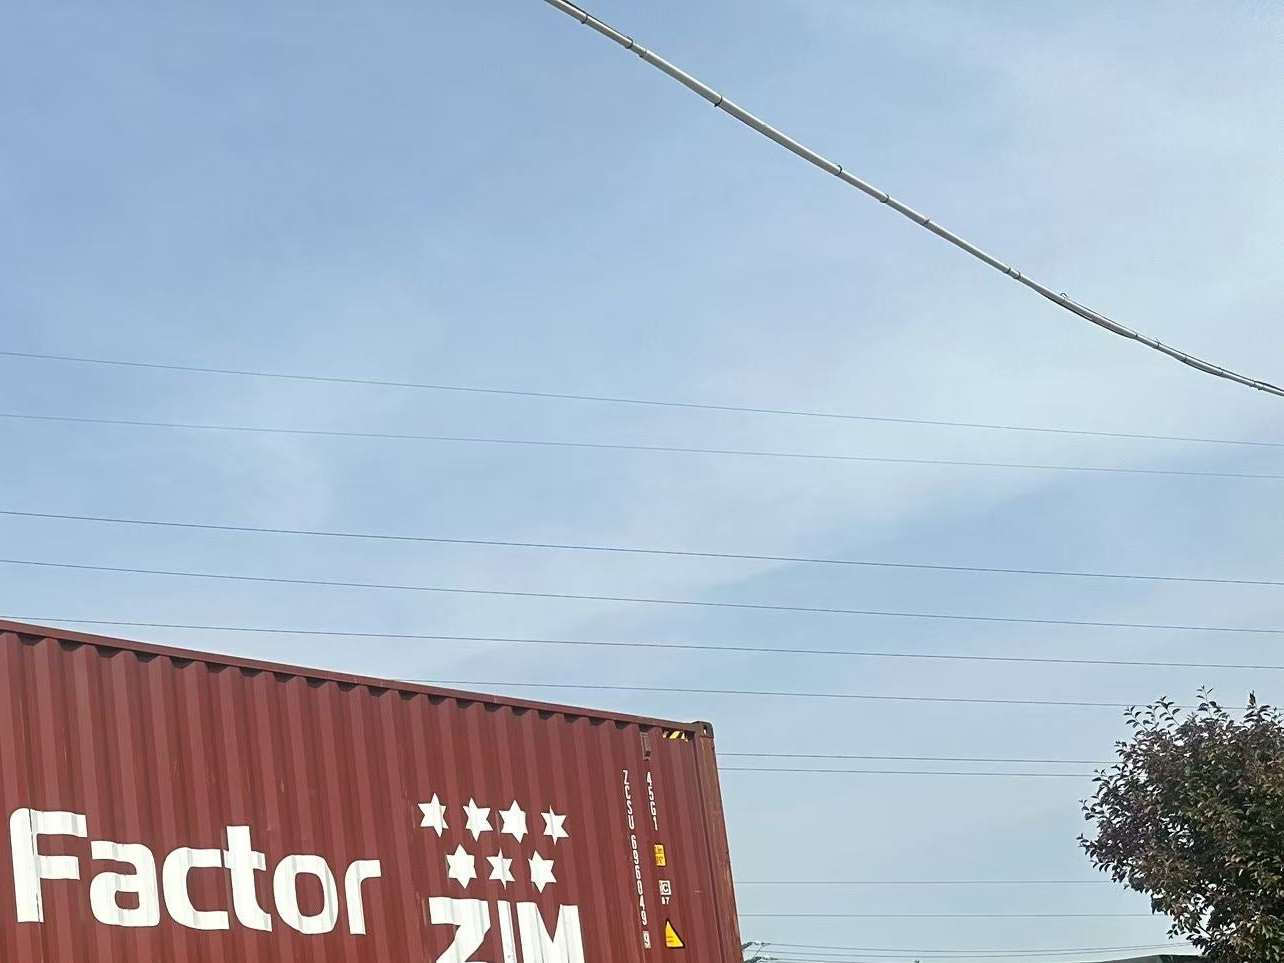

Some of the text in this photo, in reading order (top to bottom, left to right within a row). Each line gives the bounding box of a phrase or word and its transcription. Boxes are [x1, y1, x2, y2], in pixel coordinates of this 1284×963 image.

[622, 769, 635, 830] ZCSU
[630, 834, 648, 926] 696049
[646, 771, 658, 831] 45G1
[9, 808, 381, 935] Factor
